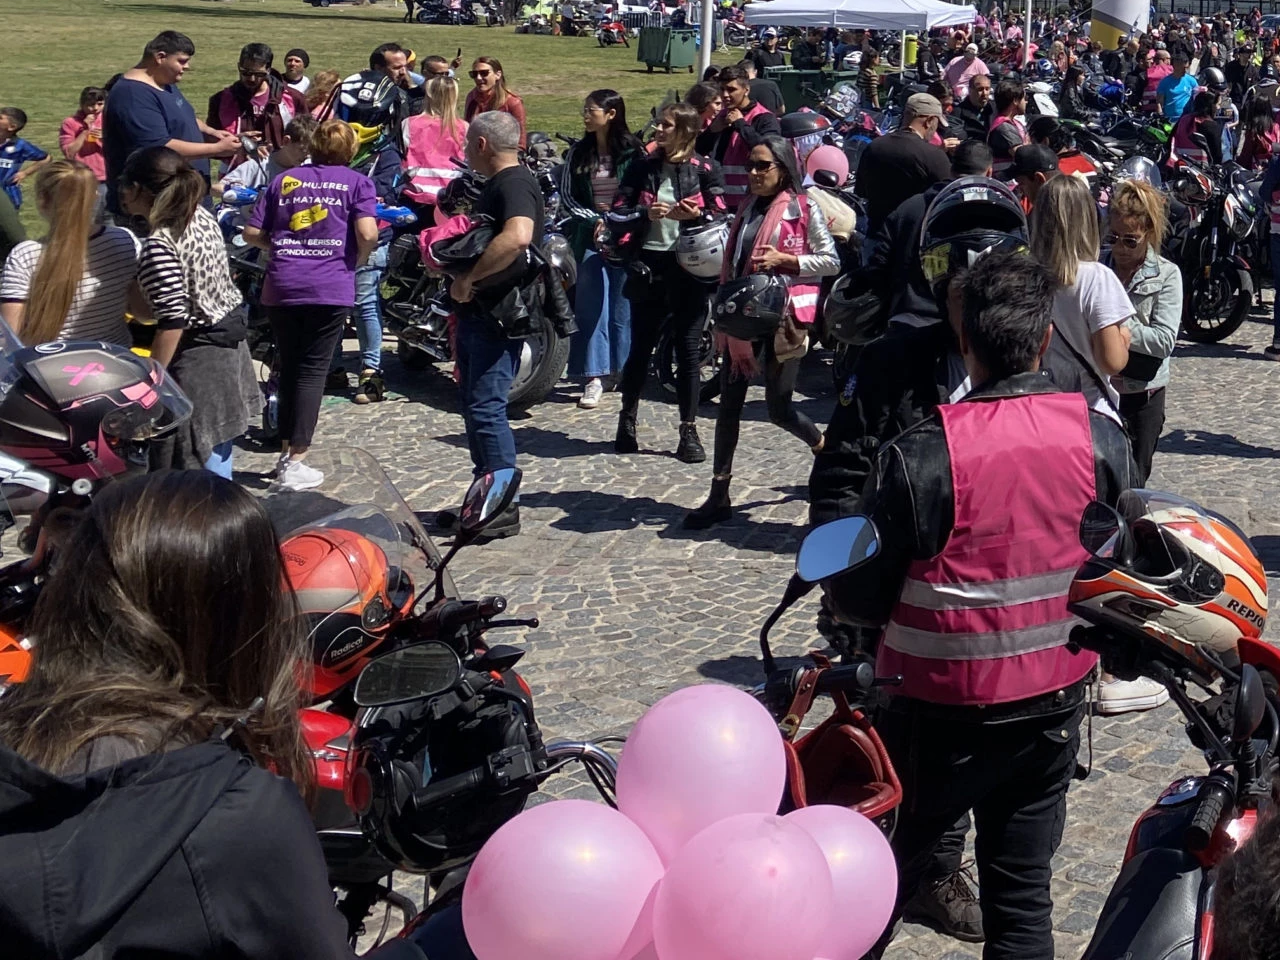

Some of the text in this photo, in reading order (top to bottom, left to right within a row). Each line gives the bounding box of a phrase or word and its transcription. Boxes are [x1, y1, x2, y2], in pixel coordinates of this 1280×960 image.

[283, 181, 349, 192] pro MUJERES
[293, 196, 343, 206] MATANZA
[277, 248, 333, 256] CONDUCCIÓN
[1227, 599, 1264, 628] REPSO
[331, 636, 364, 659] Radical
